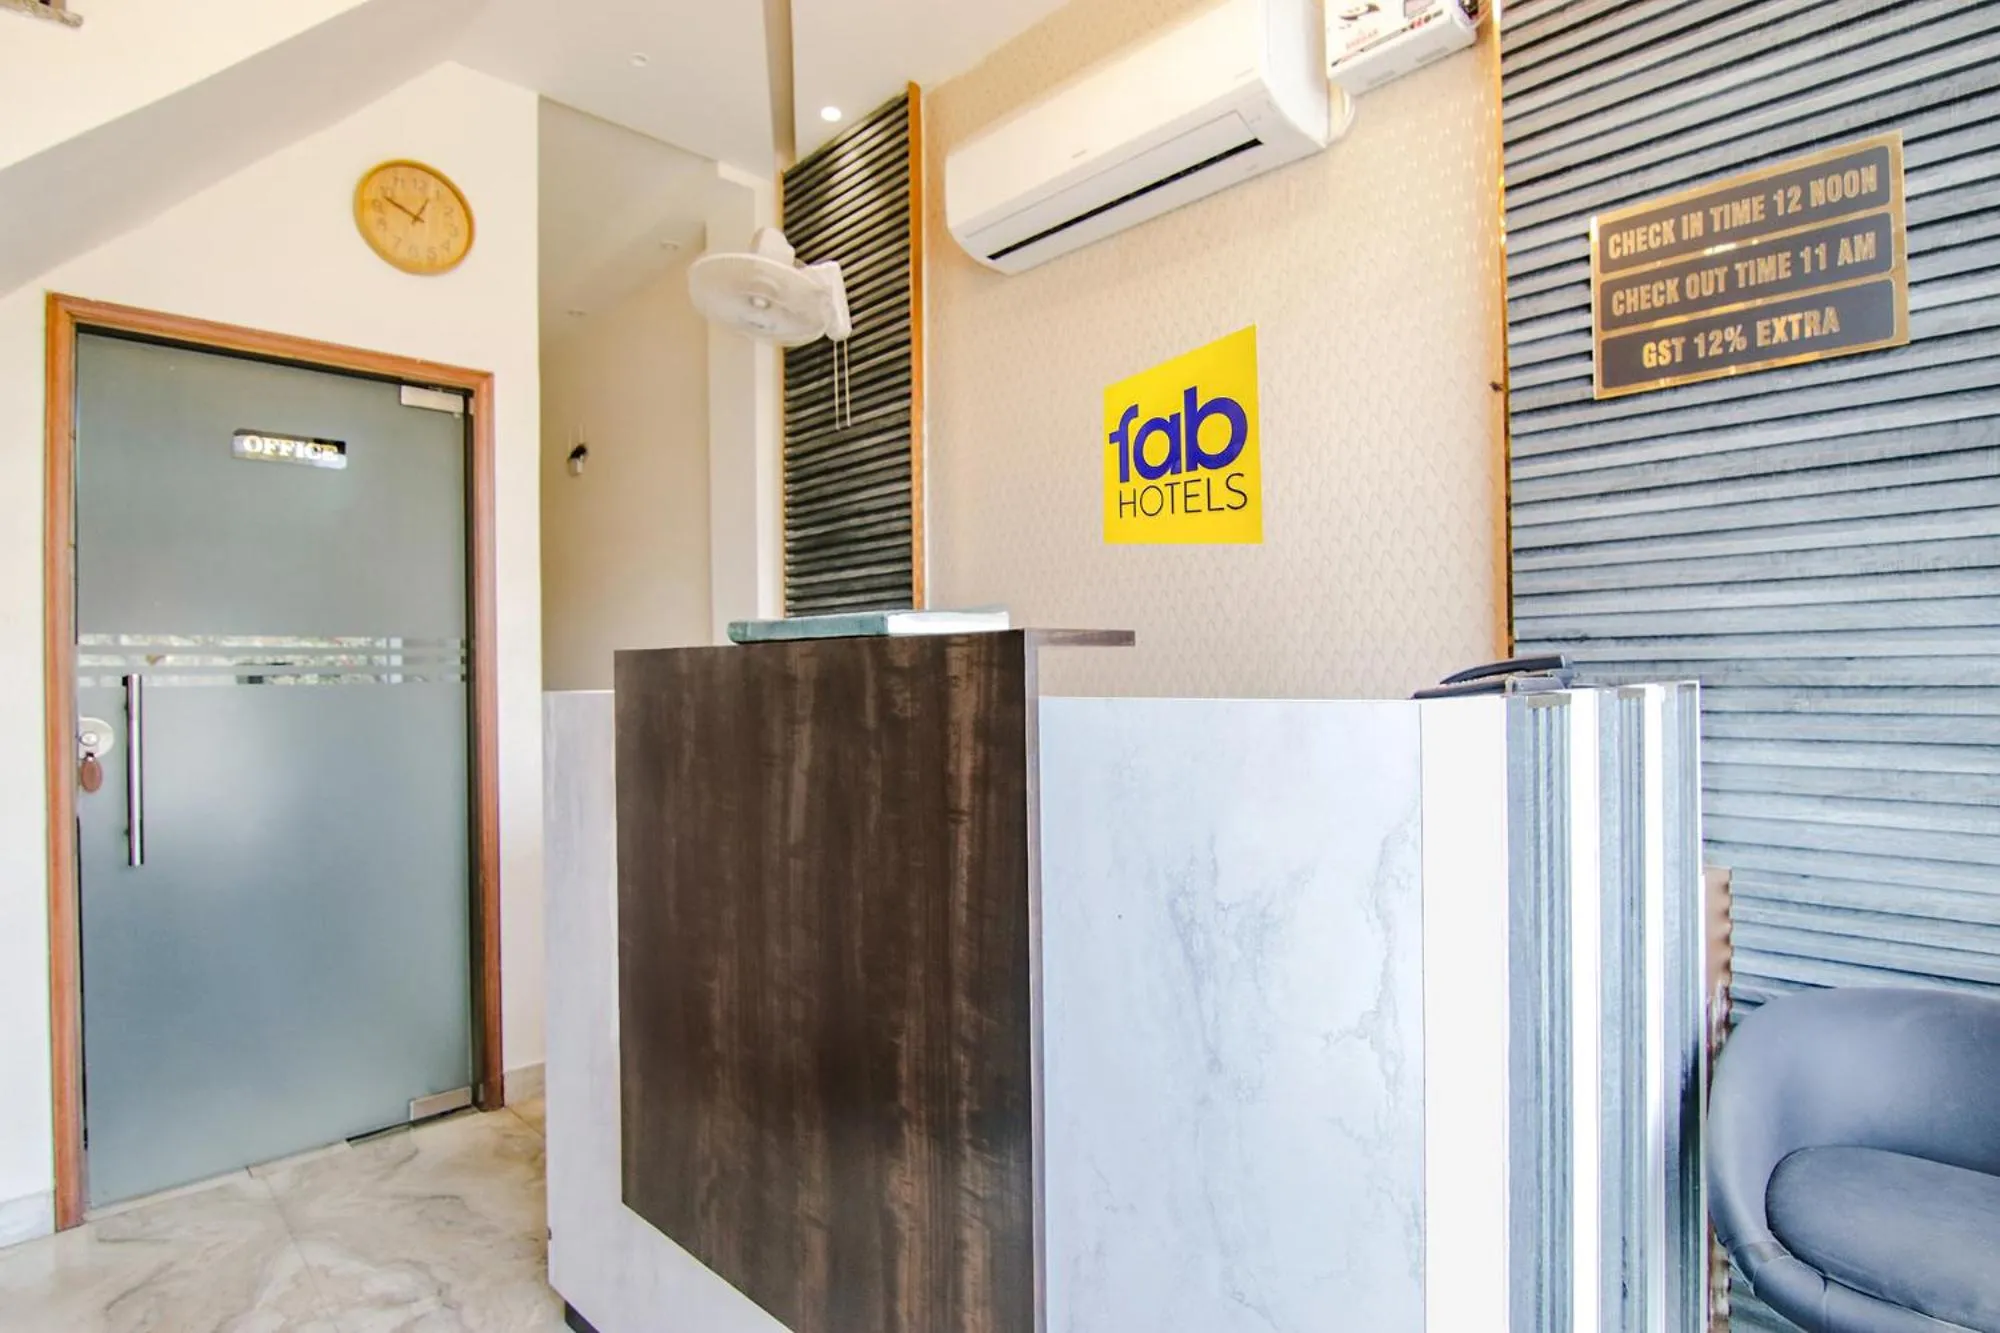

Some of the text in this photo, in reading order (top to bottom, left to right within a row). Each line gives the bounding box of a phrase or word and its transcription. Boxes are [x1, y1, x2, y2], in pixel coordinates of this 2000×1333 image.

[393, 175, 406, 190] 11
[411, 177, 429, 193] 12
[1608, 163, 1878, 260] CHECK IN TIME 12 NOON
[1611, 231, 1877, 317] CHECK OUT TIME 11 AM
[1641, 306, 1841, 369] GST 12% EXTRA
[1108, 385, 1249, 484] fab
[1119, 472, 1249, 519] HOTELS
